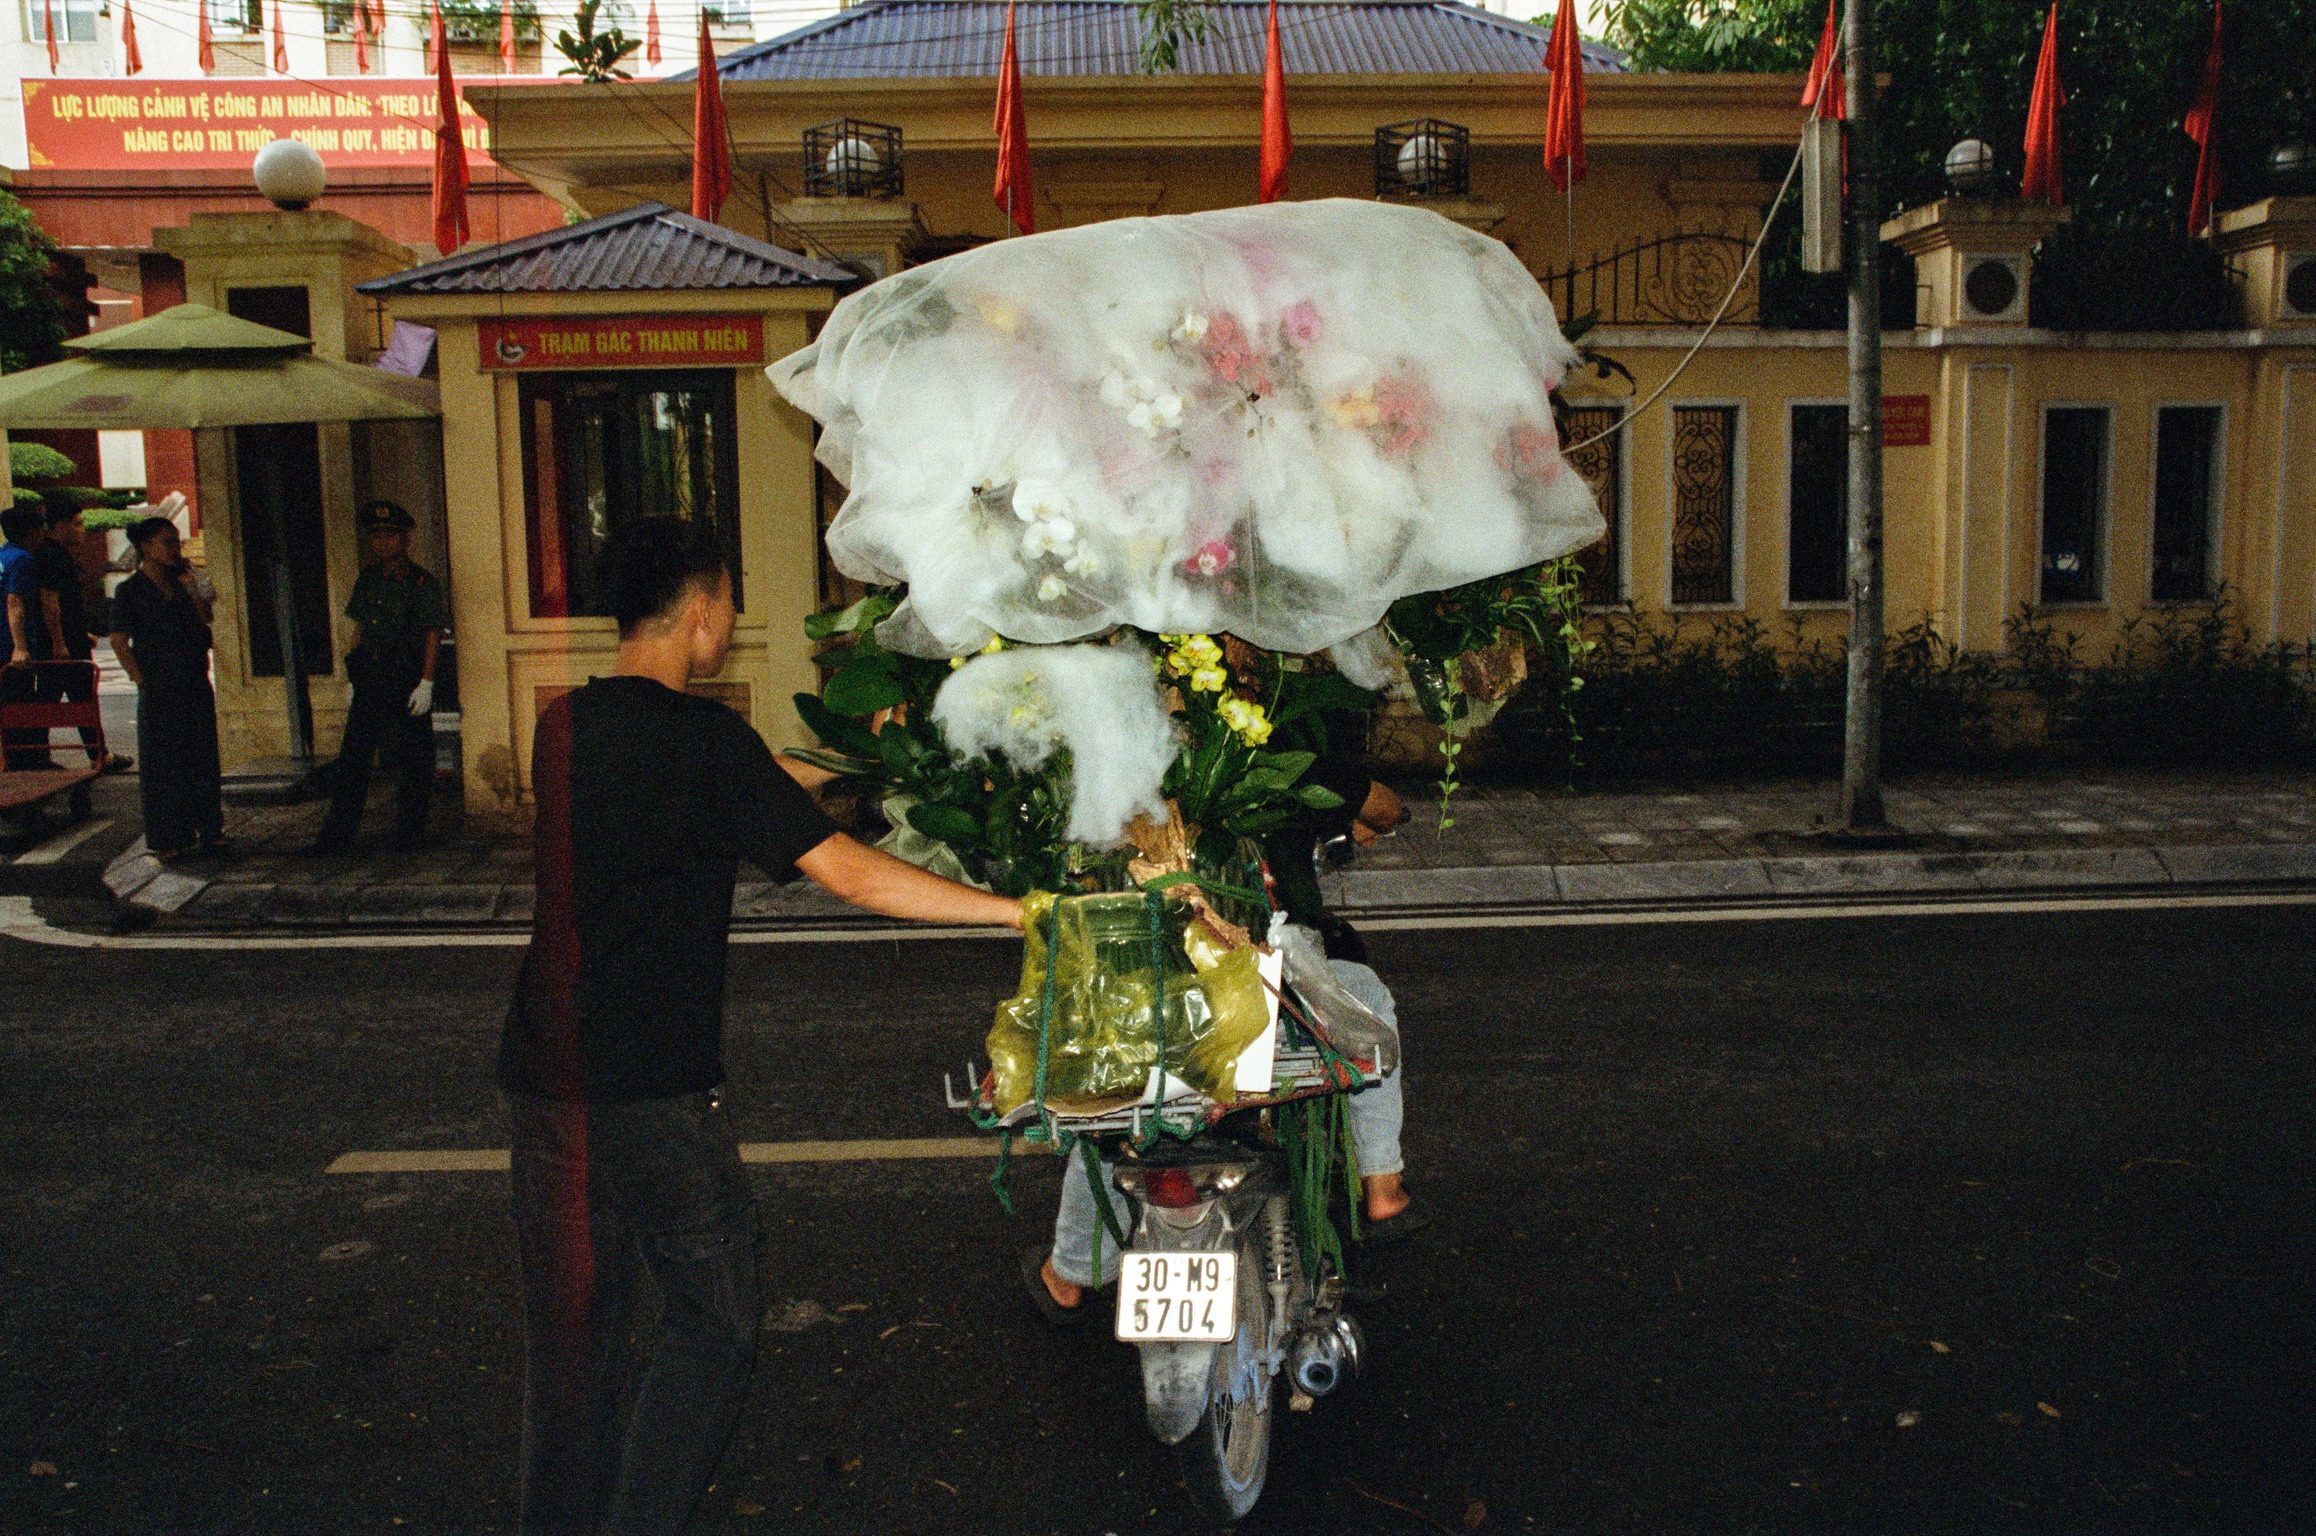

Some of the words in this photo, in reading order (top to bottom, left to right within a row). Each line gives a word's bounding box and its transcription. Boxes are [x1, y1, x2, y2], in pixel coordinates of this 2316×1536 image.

[52, 94, 83, 122] LỰC
[87, 94, 139, 122] LƯỢNG
[143, 87, 187, 118] CẢNH
[189, 91, 210, 122] VỆ
[214, 91, 257, 117] CÔNG
[261, 95, 283, 117] AN
[286, 91, 331, 117] NHÂN
[124, 126, 168, 152] NÂNG
[172, 130, 204, 152] CAO
[208, 130, 232, 151] TRI
[342, 129, 378, 153] QUY,
[381, 125, 417, 155] HIỆN
[538, 331, 590, 358] TRẠM
[595, 327, 632, 354] GÁC
[637, 329, 698, 352] THANH
[703, 325, 748, 351] NIÊN
[1134, 1298, 1215, 1333] 5704
